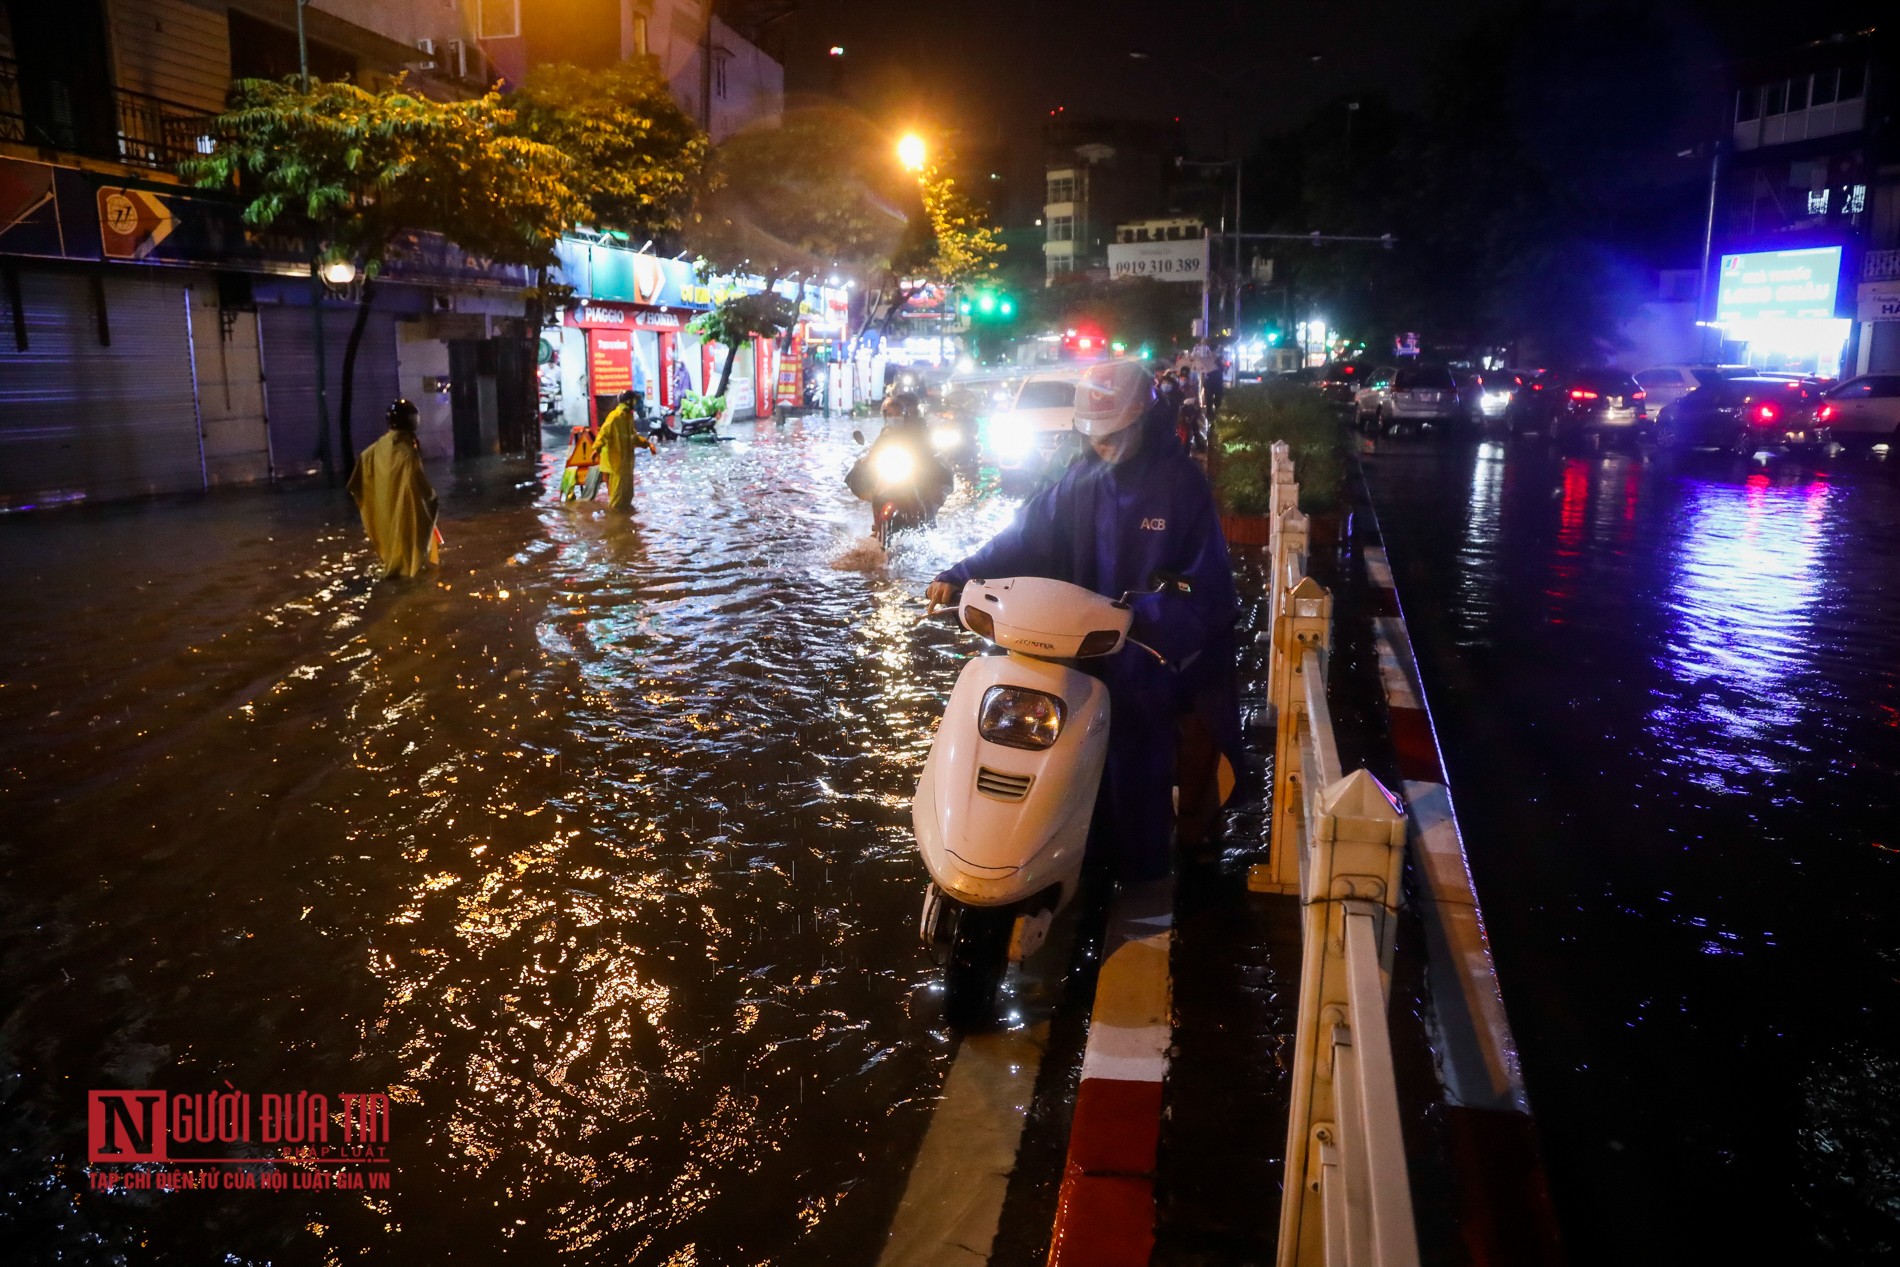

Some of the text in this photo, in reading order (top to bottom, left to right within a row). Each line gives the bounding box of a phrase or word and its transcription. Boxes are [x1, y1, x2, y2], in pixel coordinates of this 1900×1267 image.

[1116, 257, 1200, 274] 0919 310 389
[585, 307, 624, 323] PIAGGIO
[646, 312, 680, 327] HONDA
[1139, 517, 1166, 531] ACB
[1015, 638, 1055, 650] HONDA
